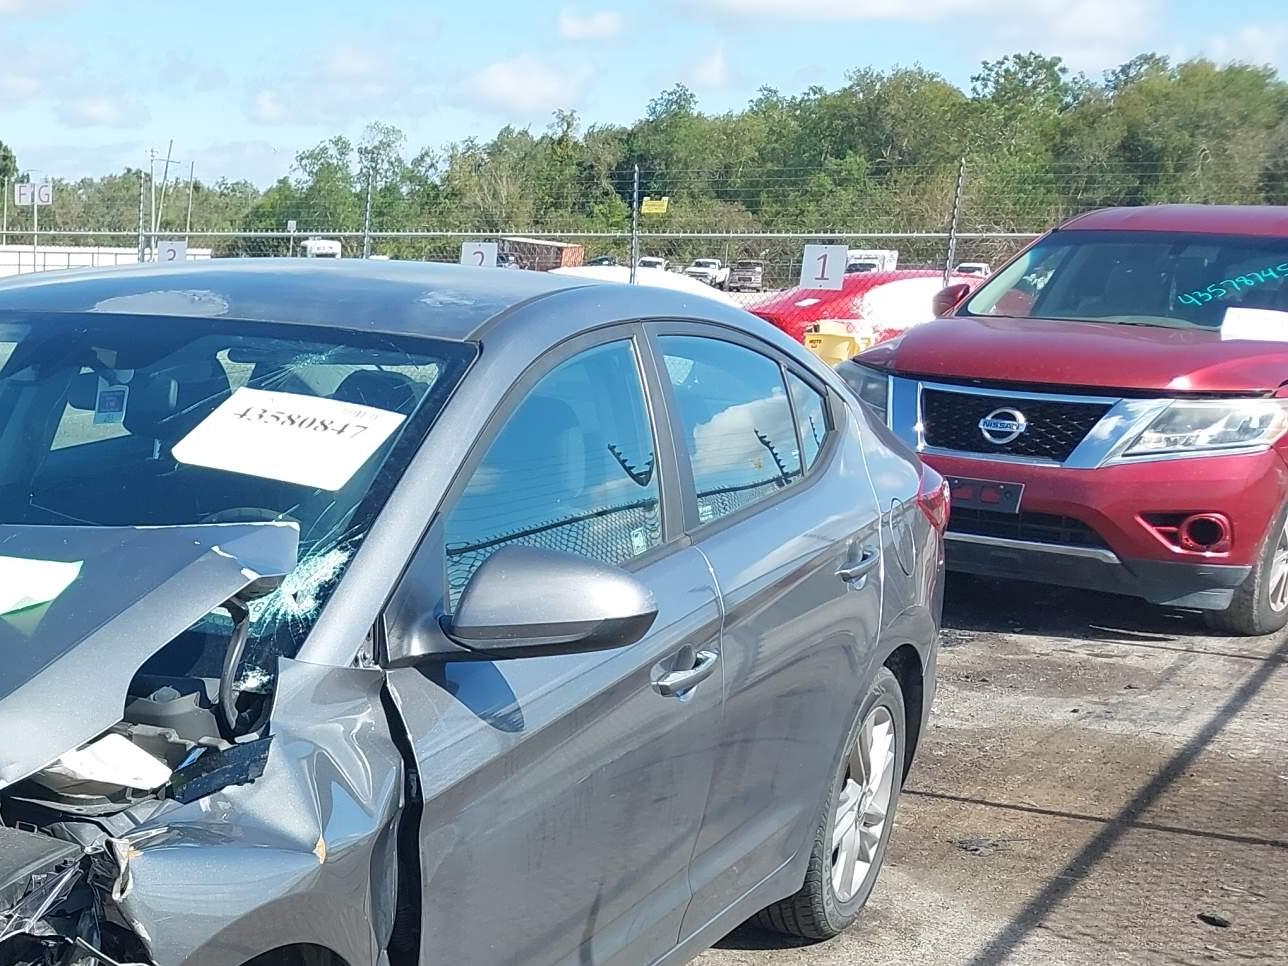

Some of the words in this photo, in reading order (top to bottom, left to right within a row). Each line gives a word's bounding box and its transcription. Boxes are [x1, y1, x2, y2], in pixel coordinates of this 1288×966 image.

[18, 184, 27, 204] F
[38, 184, 50, 203] G
[814, 253, 830, 281] 1
[233, 406, 369, 439] 43580847
